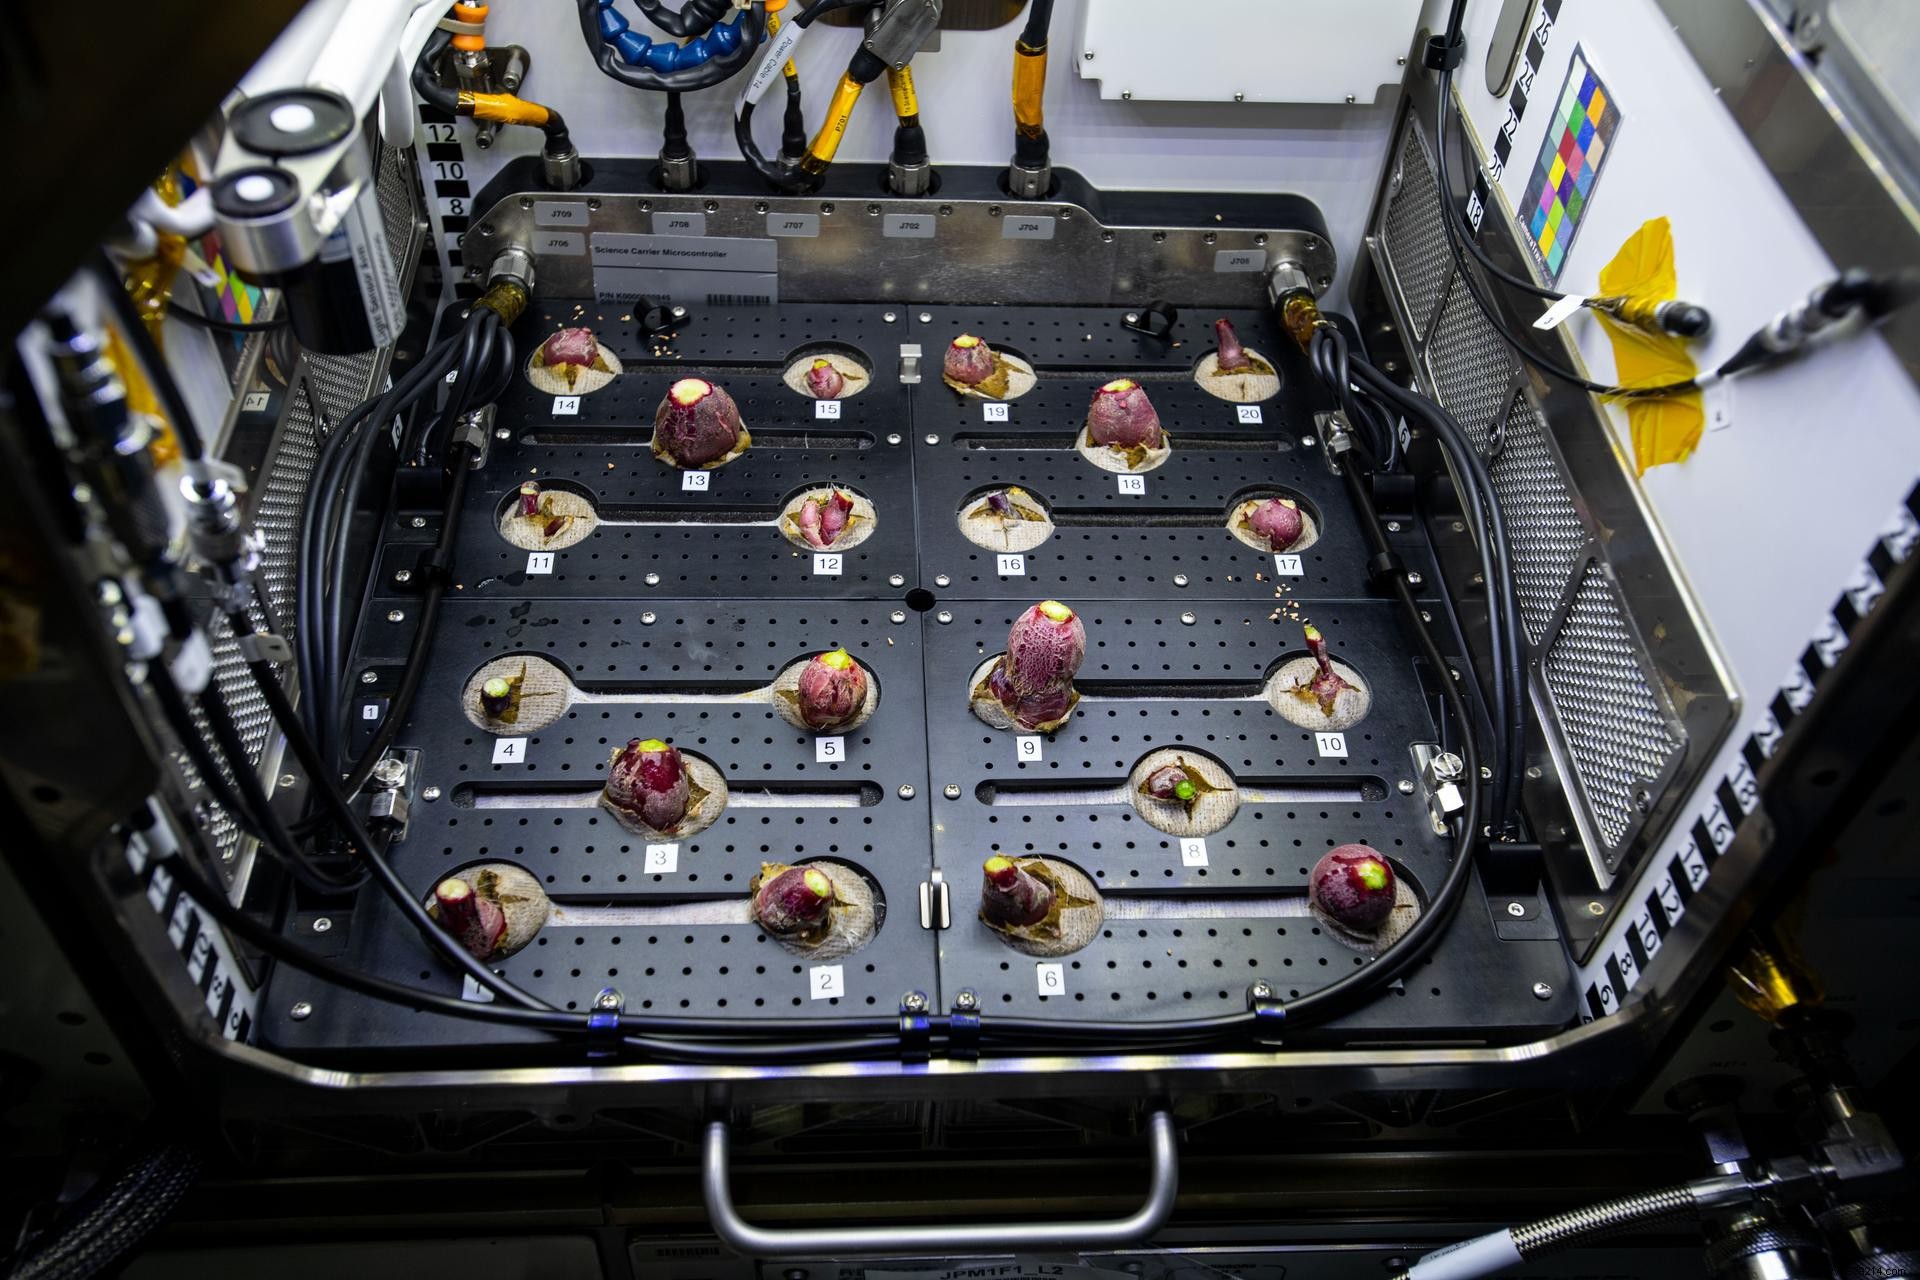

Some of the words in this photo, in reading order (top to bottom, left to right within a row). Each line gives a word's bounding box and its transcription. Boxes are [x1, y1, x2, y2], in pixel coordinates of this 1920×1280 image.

[1535, 11, 1551, 46] 26
[775, 36, 793, 62] Power
[760, 55, 777, 80] Cable
[1518, 61, 1534, 95] 24
[834, 114, 848, 133] P701
[1503, 108, 1518, 142] 22
[428, 124, 457, 143] 12
[436, 162, 464, 180] 10
[450, 198, 464, 216] 8
[551, 210, 572, 218] J709
[1469, 196, 1482, 227] 18
[668, 221, 689, 229] J708
[783, 222, 803, 230] J707
[899, 222, 919, 231] J702
[1018, 224, 1039, 232] J704
[595, 246, 629, 255] Science
[631, 248, 661, 256] Carrier
[662, 249, 727, 258] Microcontroller
[556, 400, 575, 410] 14
[820, 404, 838, 414] 15
[988, 406, 1005, 416] 19
[1240, 409, 1260, 419] 20
[687, 475, 706, 486] 13
[1121, 479, 1141, 489] 18
[532, 557, 549, 569] 11
[819, 558, 838, 570] 12
[1002, 559, 1021, 570] 16
[1280, 559, 1297, 570] 17
[368, 707, 373, 717] 1
[503, 743, 515, 757] 4
[824, 741, 836, 756] 5
[1023, 741, 1035, 755] 9
[1320, 737, 1342, 751] 10
[1732, 763, 1757, 806] 18
[1706, 804, 1726, 846] 16
[655, 850, 667, 866] 3
[1188, 844, 1201, 859] 8
[1683, 842, 1704, 884] 14
[1661, 879, 1680, 921] 12
[1638, 913, 1658, 952] 10
[1620, 952, 1632, 976] 8
[820, 974, 833, 990] 2
[1046, 972, 1057, 987] 6
[1601, 984, 1613, 1005] 6
[940, 1264, 1064, 1280] JPM1F1_L2
